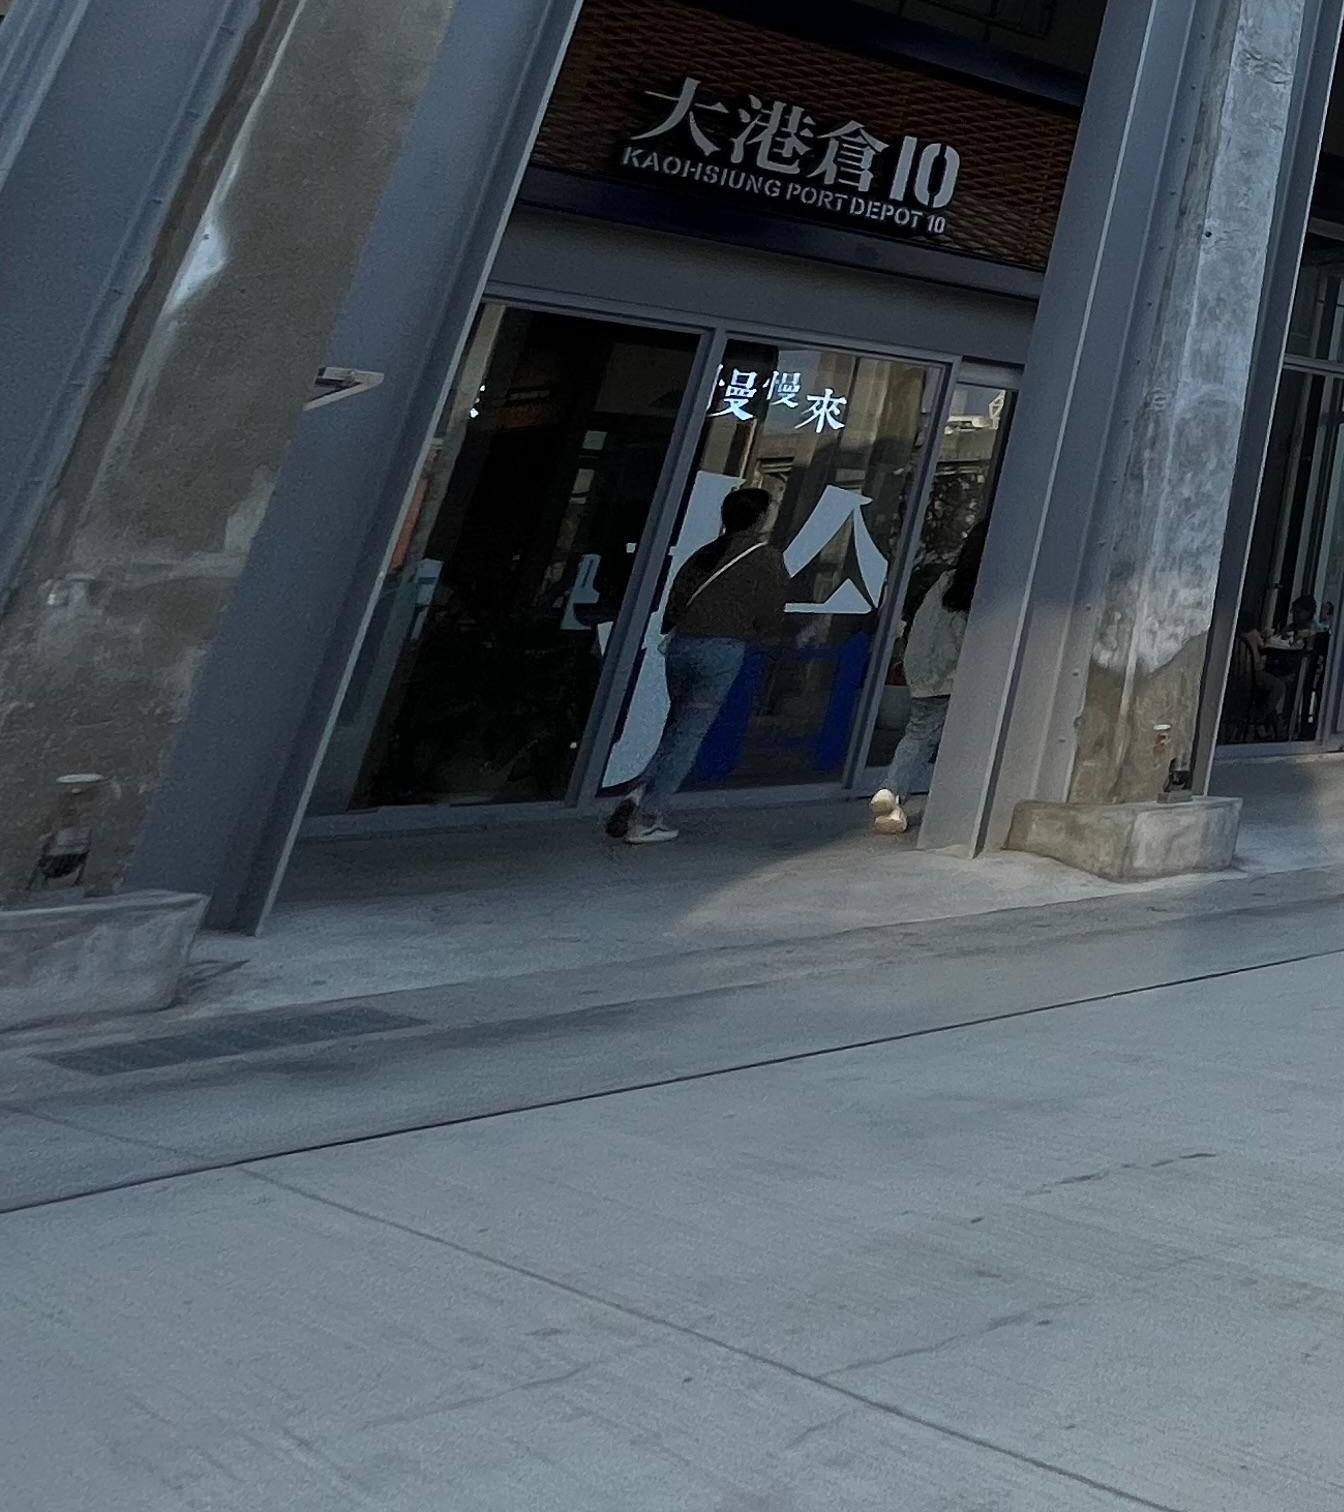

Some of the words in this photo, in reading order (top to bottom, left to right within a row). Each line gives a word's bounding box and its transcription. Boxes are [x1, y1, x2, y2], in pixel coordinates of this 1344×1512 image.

[630, 76, 962, 210] 大港倉10
[622, 145, 782, 199] KAOHSIUNG
[785, 182, 849, 213] PORT
[849, 196, 924, 230] DEPOT
[926, 214, 947, 235] 10
[705, 363, 849, 434] 慢慢來
